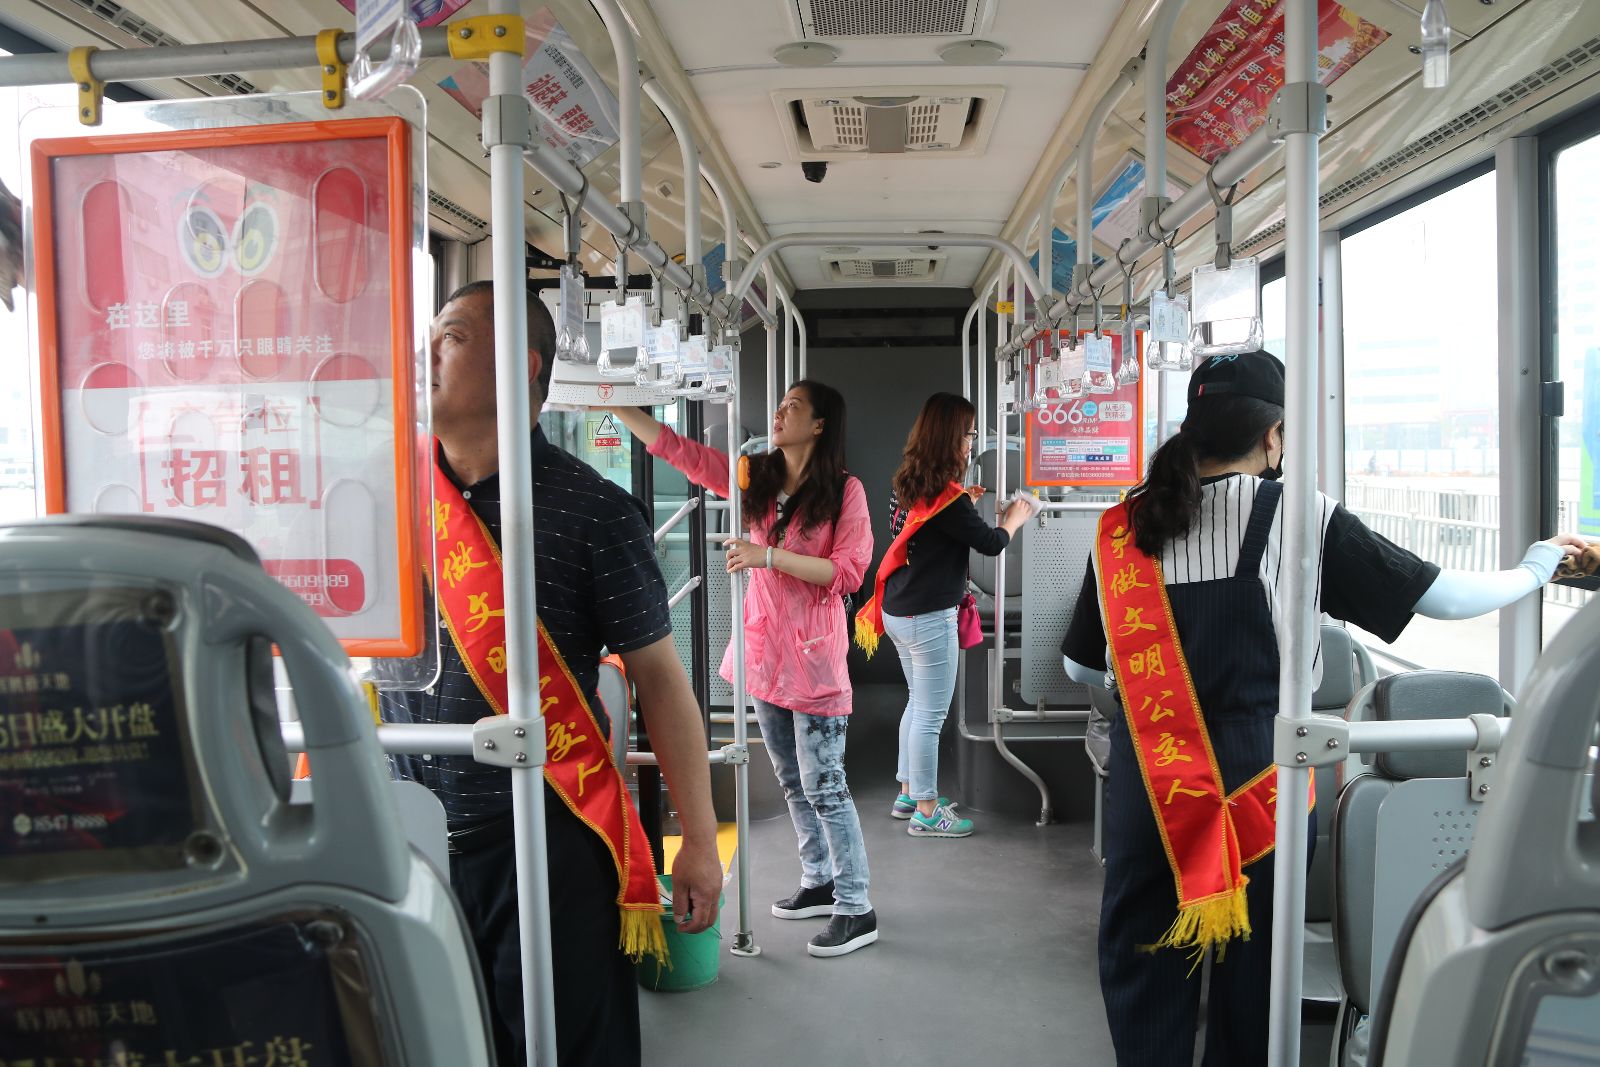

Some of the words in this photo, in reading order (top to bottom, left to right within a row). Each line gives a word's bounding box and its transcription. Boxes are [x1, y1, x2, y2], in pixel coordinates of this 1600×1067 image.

[1214, 86, 1239, 110] 民主
[1238, 60, 1265, 86] 文明
[1256, 72, 1282, 96] 公正
[105, 301, 192, 329] 在这里
[137, 335, 334, 361] 您将被千万只眼睛关注
[1037, 400, 1083, 425] 666
[160, 447, 307, 508] 招租
[1110, 526, 1209, 805] 争做文明公交人
